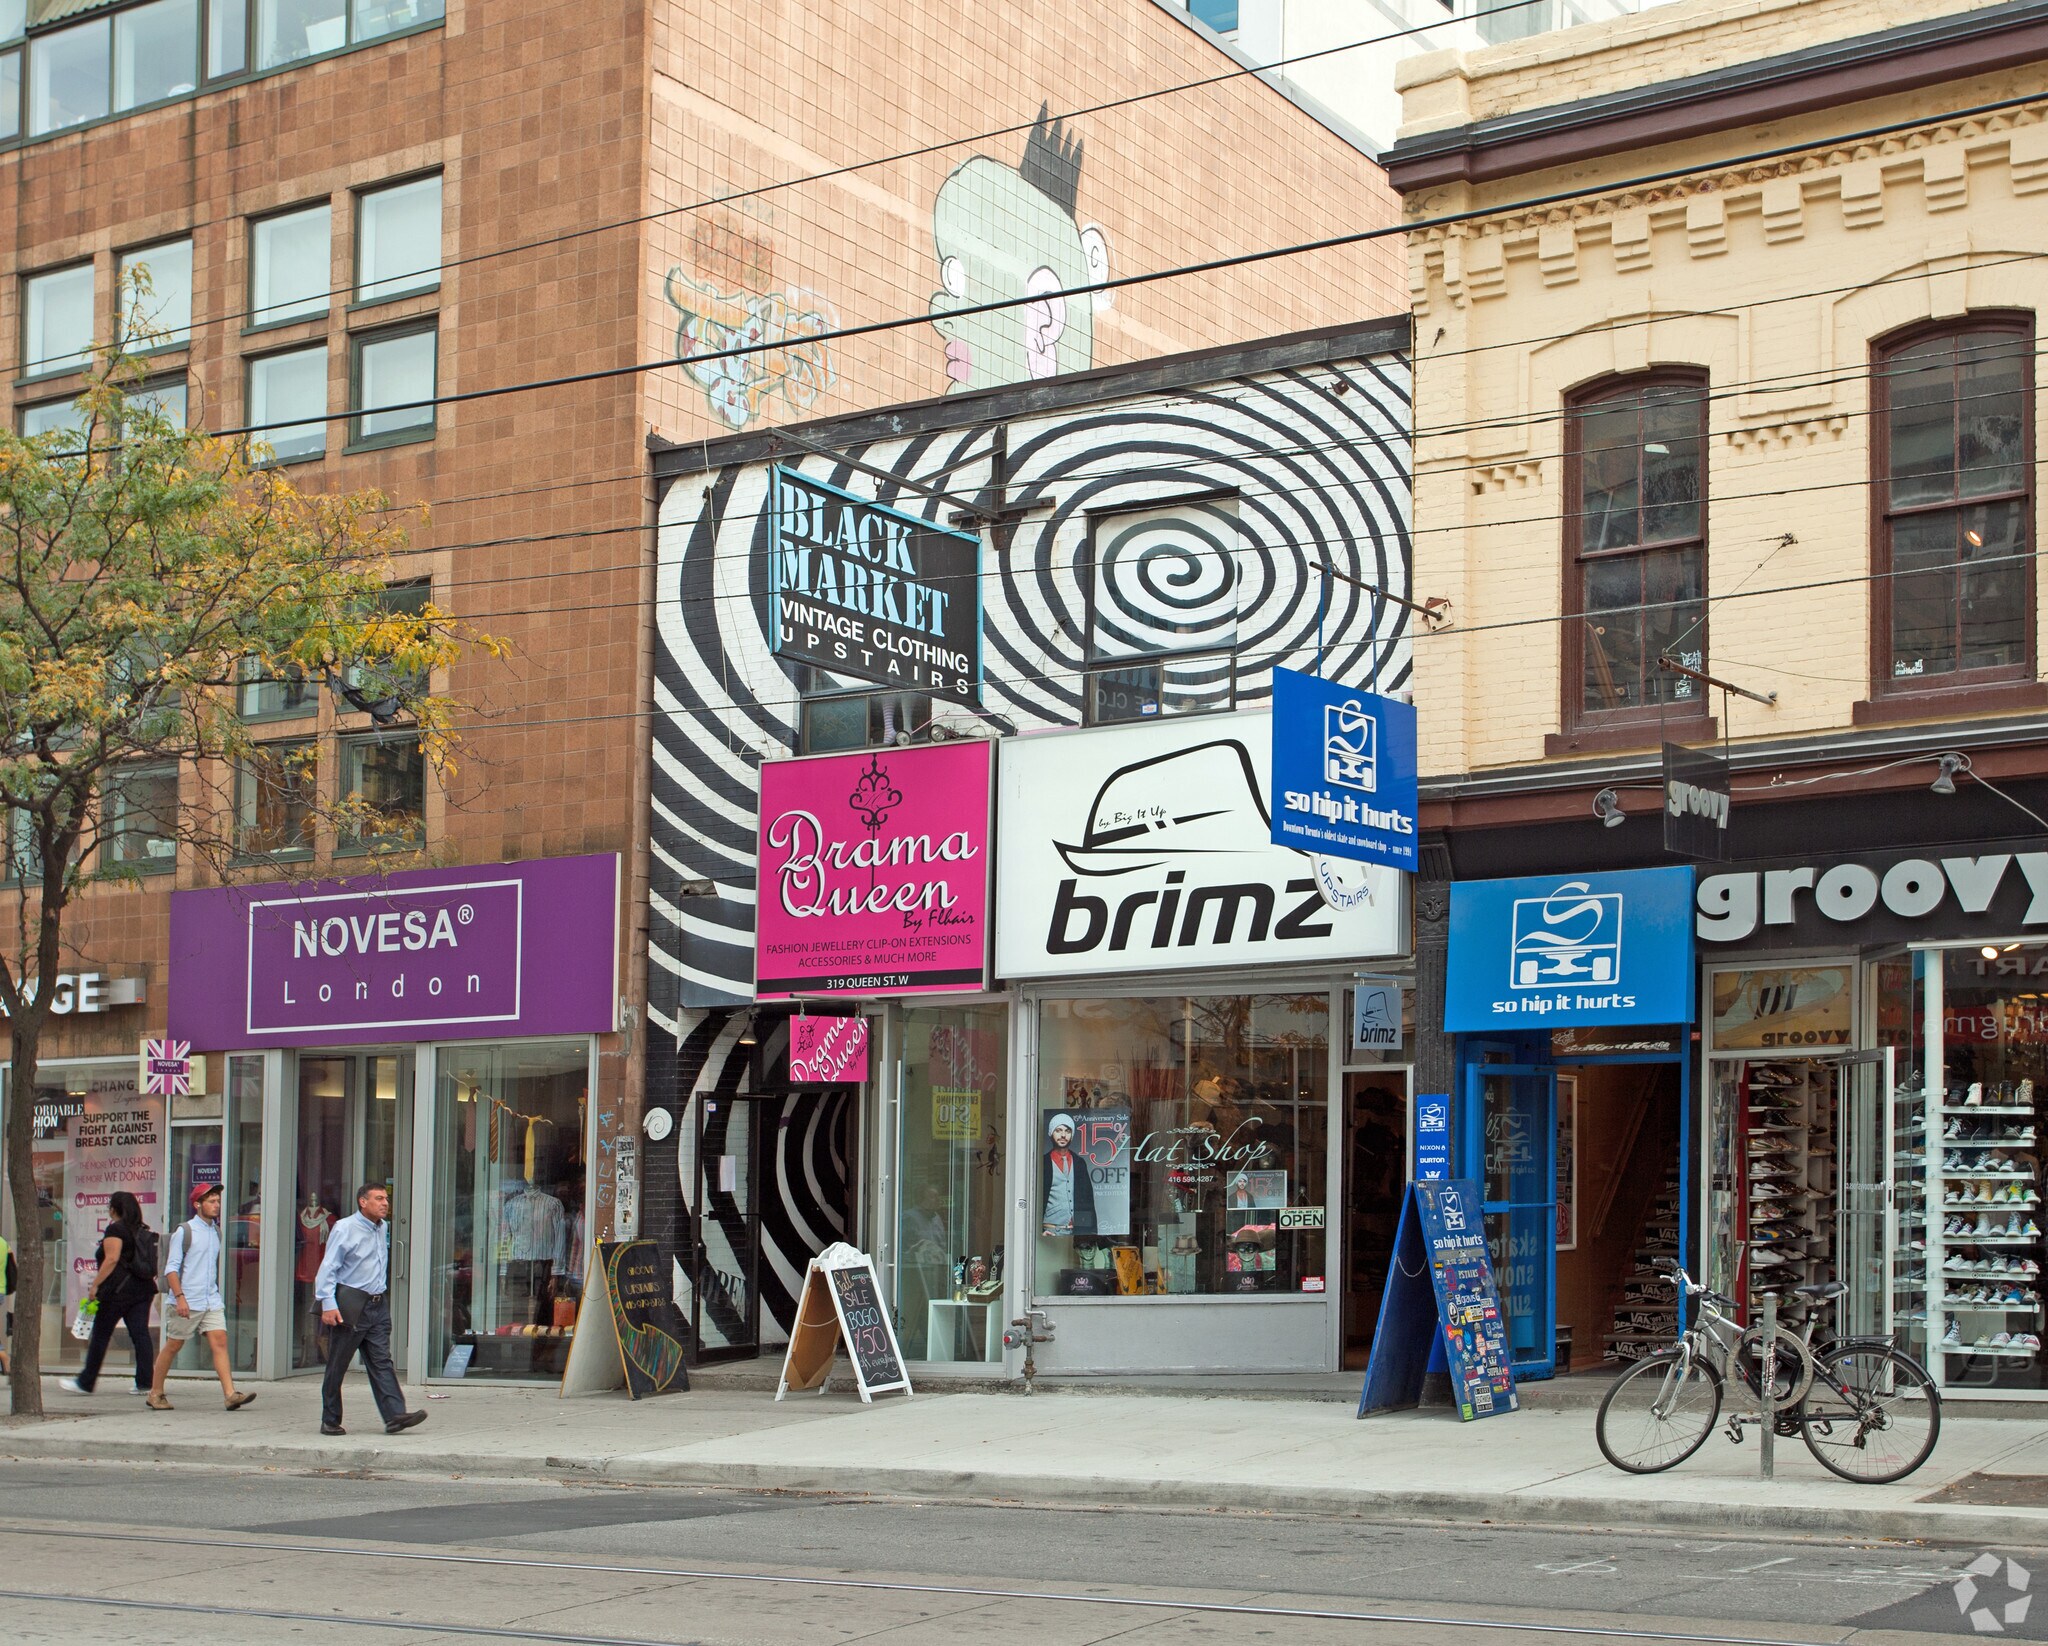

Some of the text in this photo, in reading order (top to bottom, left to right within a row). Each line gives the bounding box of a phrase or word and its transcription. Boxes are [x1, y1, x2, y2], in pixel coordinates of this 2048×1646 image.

[781, 482, 916, 575] BLACK
[781, 539, 949, 637] MARKET
[781, 597, 969, 674] VINTAGE CLOTHING
[781, 625, 968, 695] UPSTAIRS
[1284, 791, 1413, 834] so hip it hurts
[1668, 780, 1730, 829] groovy
[1114, 812, 1132, 825] Big
[1137, 809, 1147, 819] It
[1151, 805, 1166, 818] Up
[767, 810, 979, 873] Drama
[780, 855, 959, 918] Queen
[1320, 862, 1369, 907] UPSTAIRS
[903, 909, 975, 933] By Flhair
[1046, 871, 1333, 955] brimz
[766, 934, 971, 954] FASHION JEWELLERY CLIP-ON EXTENSIONS
[798, 951, 936, 968] ACCESSORIES & MUCH MORE
[285, 974, 480, 1004] London
[827, 975, 909, 989] 319 QUEEN ST. W
[1492, 993, 1636, 1014] so hip it hurts
[1360, 1023, 1396, 1043] brimz
[1761, 1029, 1850, 1047] groovy
[790, 1016, 849, 1082] Drama
[819, 1017, 869, 1082] Queen
[92, 1080, 139, 1093] CHANG
[83, 1110, 150, 1124] SUPPORT THE
[79, 1122, 153, 1136] FIGHT AGAINST
[76, 1134, 157, 1148] BREAST CANCER
[1077, 1122, 1127, 1166] 15%
[80, 1156, 152, 1169] THE MORE YOU SHOP
[1112, 1117, 1272, 1188] Hat Shop
[75, 1170, 156, 1184] THE MORE WE DONATE!
[1091, 1167, 1128, 1184] OFF
[89, 1196, 103, 1205] YOU
[1267, 1188, 1283, 1197] OFF
[1280, 1213, 1323, 1227] OPEN
[1433, 1234, 1483, 1250] so hip it hurts
[844, 1289, 870, 1307] SALE
[846, 1307, 880, 1330] BOGO
